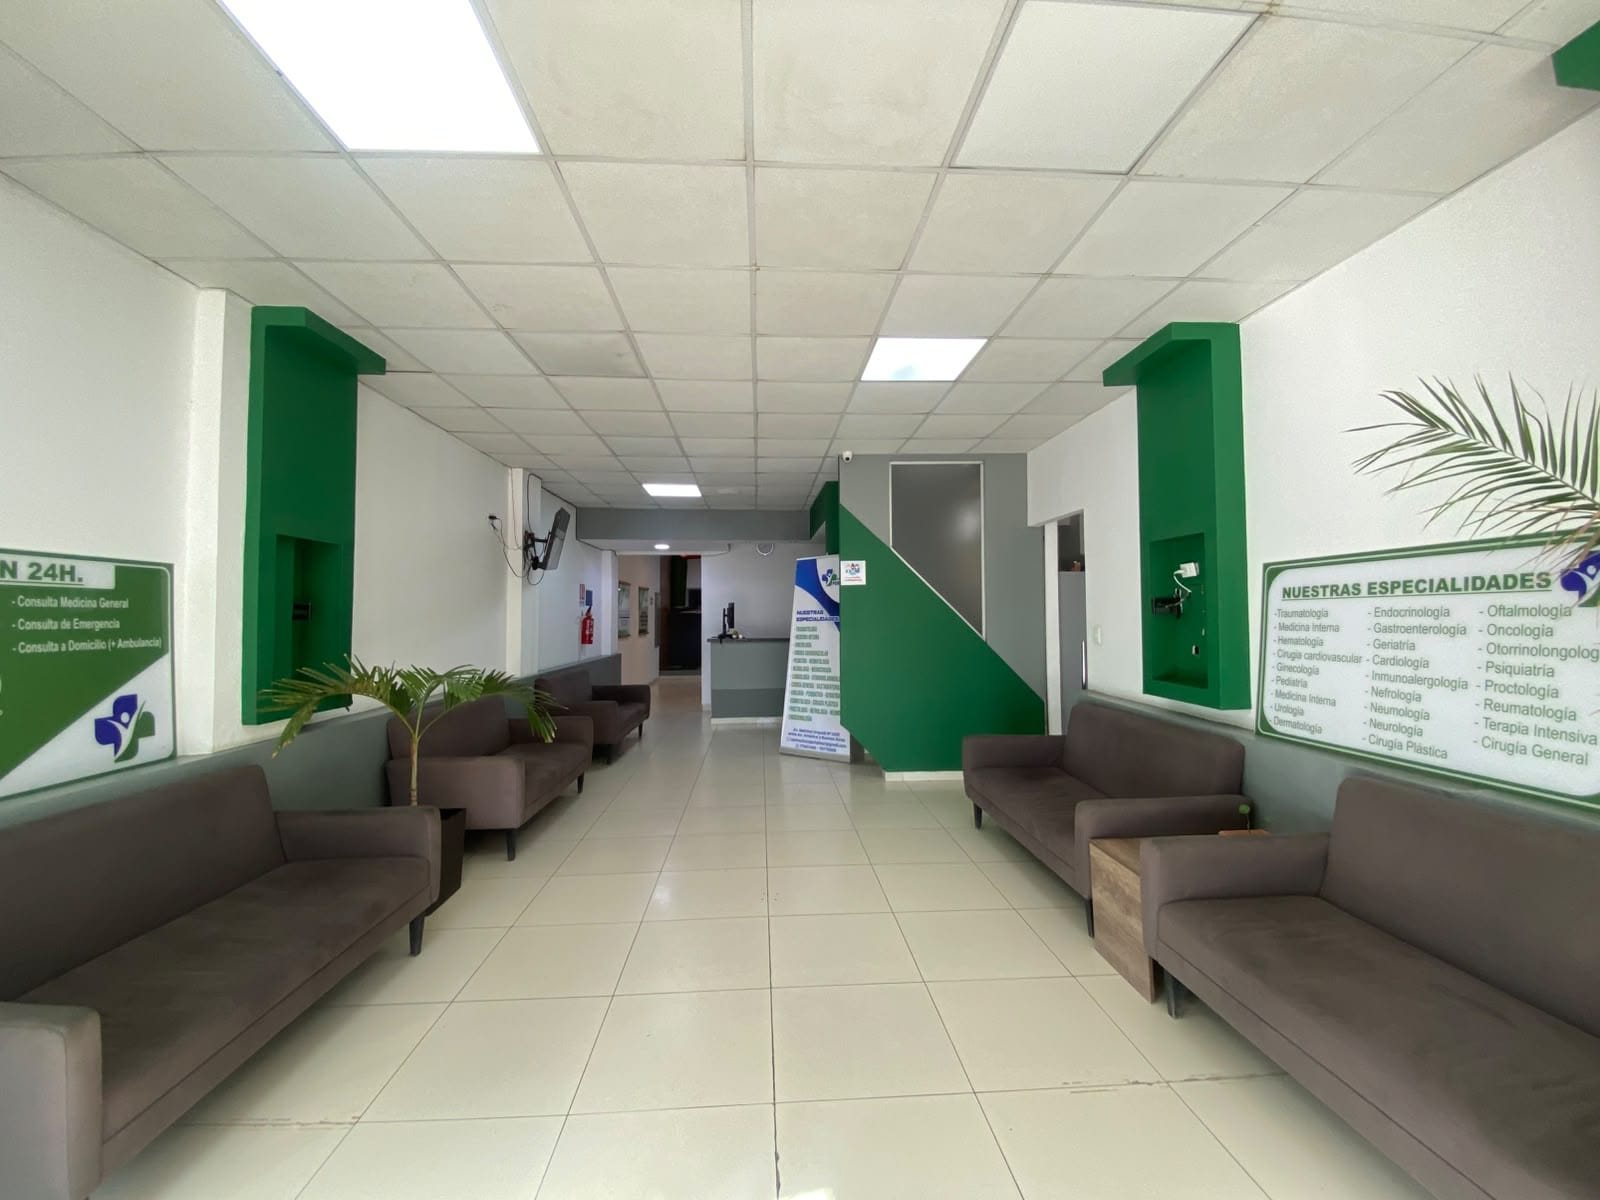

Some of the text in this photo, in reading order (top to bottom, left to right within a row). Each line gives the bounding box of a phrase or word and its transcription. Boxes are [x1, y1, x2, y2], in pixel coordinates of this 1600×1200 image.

[28, 562, 84, 583] 24H.
[1281, 571, 1552, 599] NUESTRAS ESPECIALIDADES
[17, 595, 129, 609] Consulta Medicina General
[17, 618, 120, 631] Consulta de Emergencia
[1278, 622, 1340, 633] Medicina Interna
[18, 641, 59, 653] Consulta
[61, 643, 66, 652] a
[68, 639, 107, 652] Domicilio
[117, 637, 162, 649] Ambulancia)
[1303, 650, 1362, 664] cardiovascular
[1274, 689, 1337, 707] Medicina Interna
[1482, 716, 1598, 746] Terapia Intensiva
[1531, 743, 1589, 766] General
